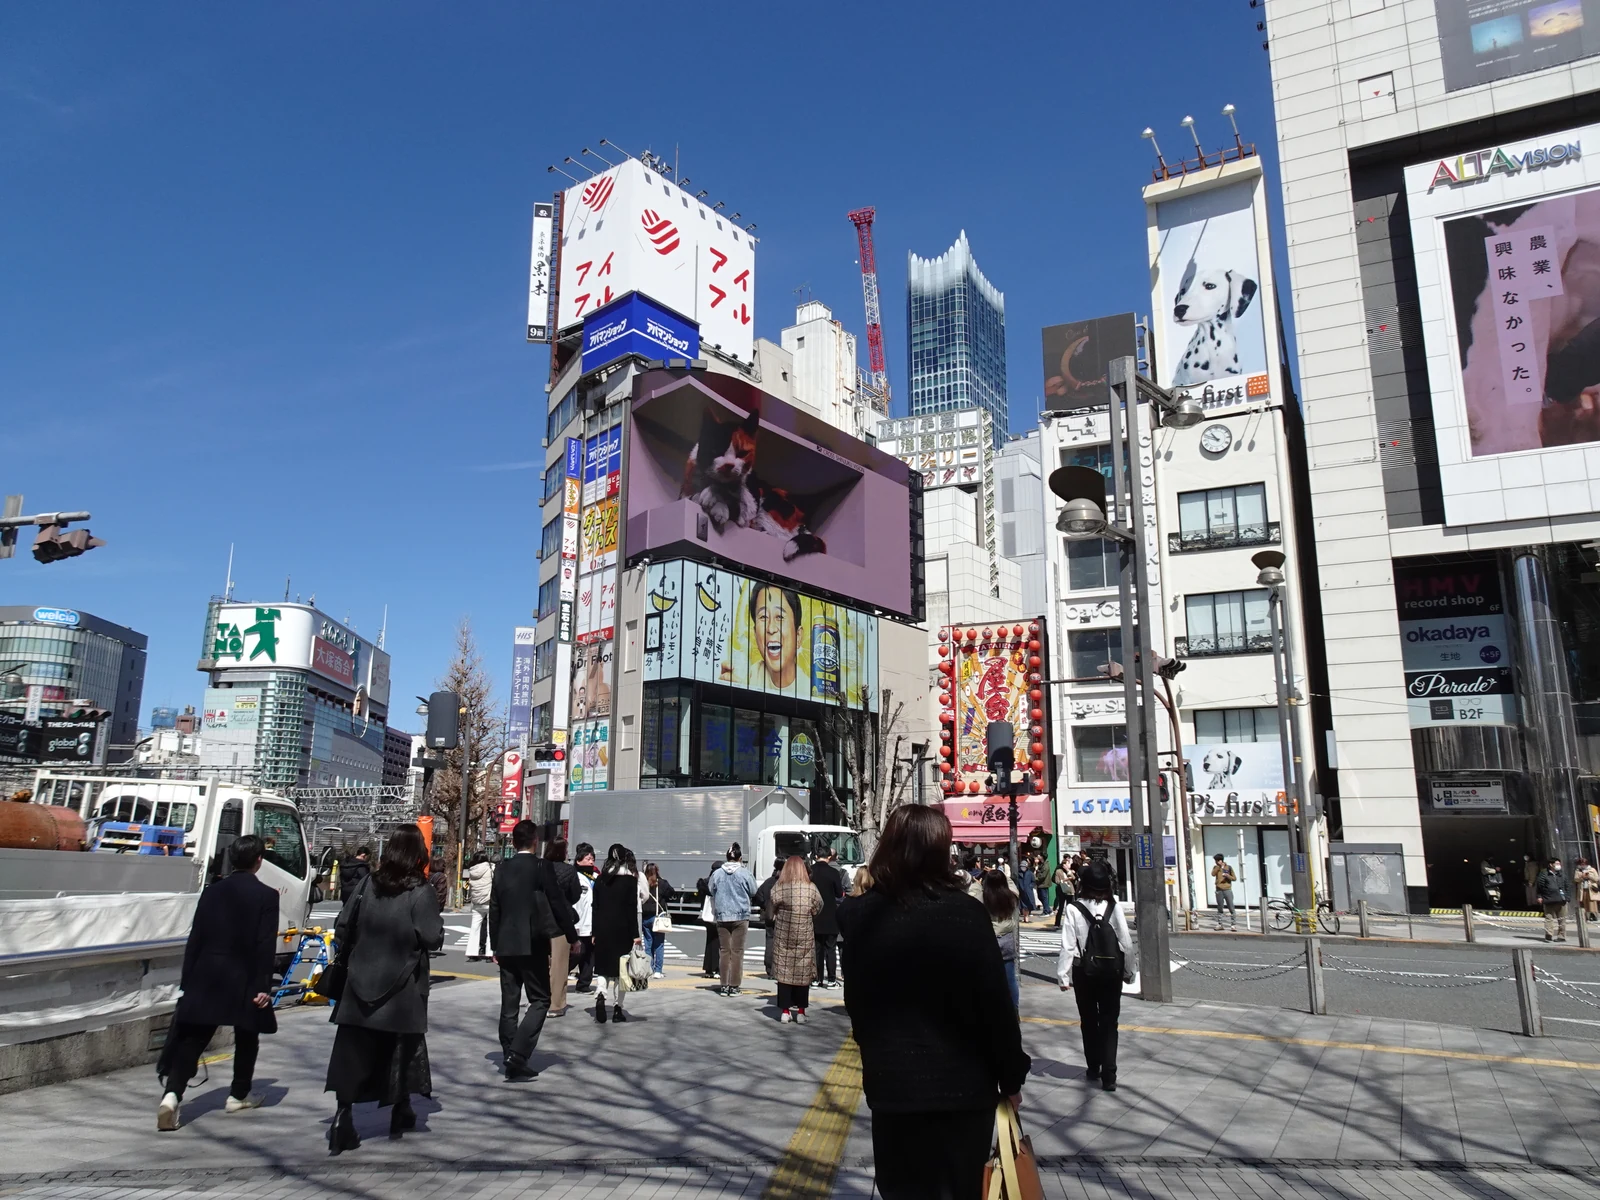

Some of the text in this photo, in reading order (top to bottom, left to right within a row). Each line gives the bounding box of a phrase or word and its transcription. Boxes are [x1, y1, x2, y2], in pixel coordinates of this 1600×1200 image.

[1429, 139, 1582, 188] ALTA VISION
[575, 251, 614, 286] アイ
[709, 246, 750, 292] アイ
[1529, 235, 1554, 289] 農業、
[708, 283, 751, 326] フル
[1494, 242, 1533, 394] 興味なかった。
[589, 318, 628, 347] アパマンショップ
[646, 321, 690, 351] アパマンショップ
[901, 448, 977, 470] ンジェリー
[922, 466, 977, 485] カダヤ
[1404, 594, 1485, 609] record shop
[1489, 604, 1500, 612] 6F
[37, 611, 77, 623] welcia
[560, 603, 571, 642] 宝石広場
[516, 632, 533, 640] HIS
[666, 610, 681, 666] いいレモン。
[1406, 624, 1491, 643] okadaya
[974, 642, 1015, 652] YATAIEN
[1440, 651, 1461, 662] 生地
[316, 647, 351, 677] 大塚商会
[521, 657, 531, 706] 海外・国内旅行
[1408, 672, 1497, 697] Parade
[46, 721, 96, 729] THEグローバル社
[1459, 708, 1485, 720] B2F
[48, 738, 79, 752] global
[1071, 798, 1095, 814] 16
